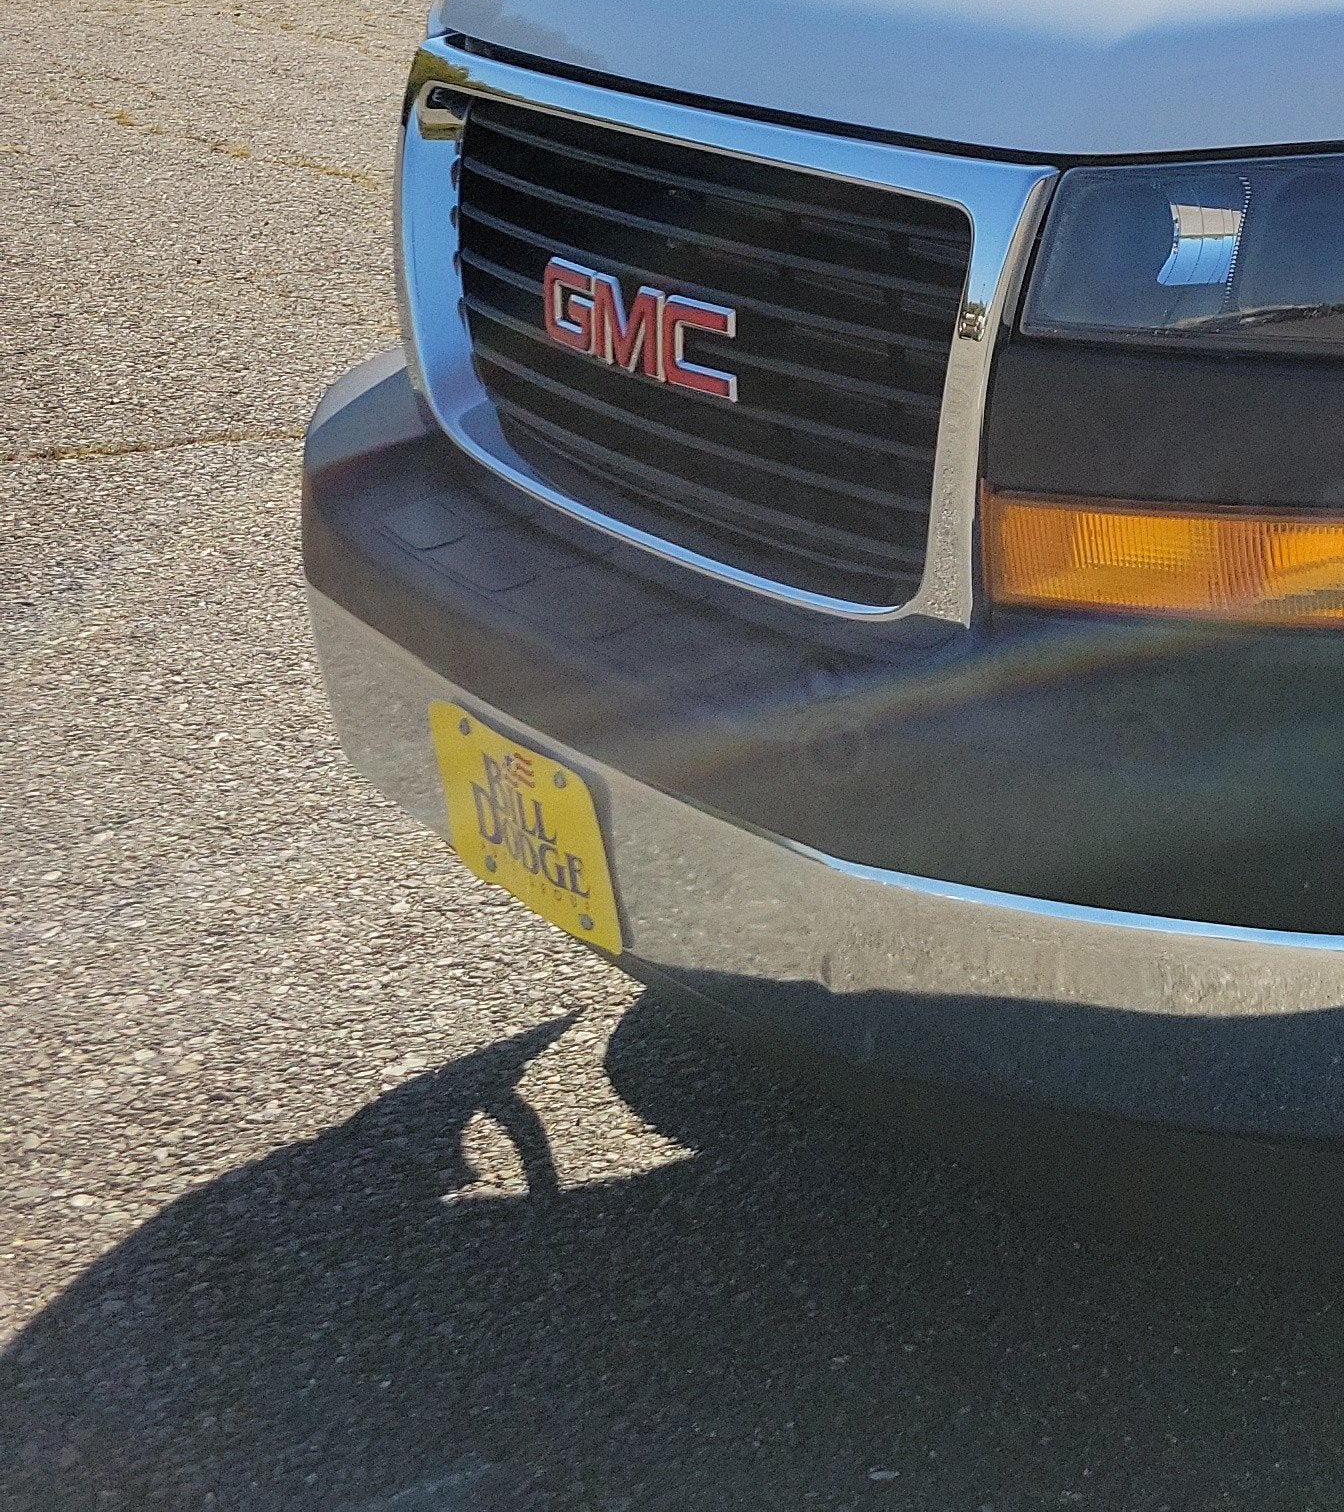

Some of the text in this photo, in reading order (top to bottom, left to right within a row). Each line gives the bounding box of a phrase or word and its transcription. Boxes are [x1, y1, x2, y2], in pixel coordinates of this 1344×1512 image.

[543, 255, 738, 403] GMC
[470, 780, 590, 899] DODGE
[482, 751, 557, 846] BILL
